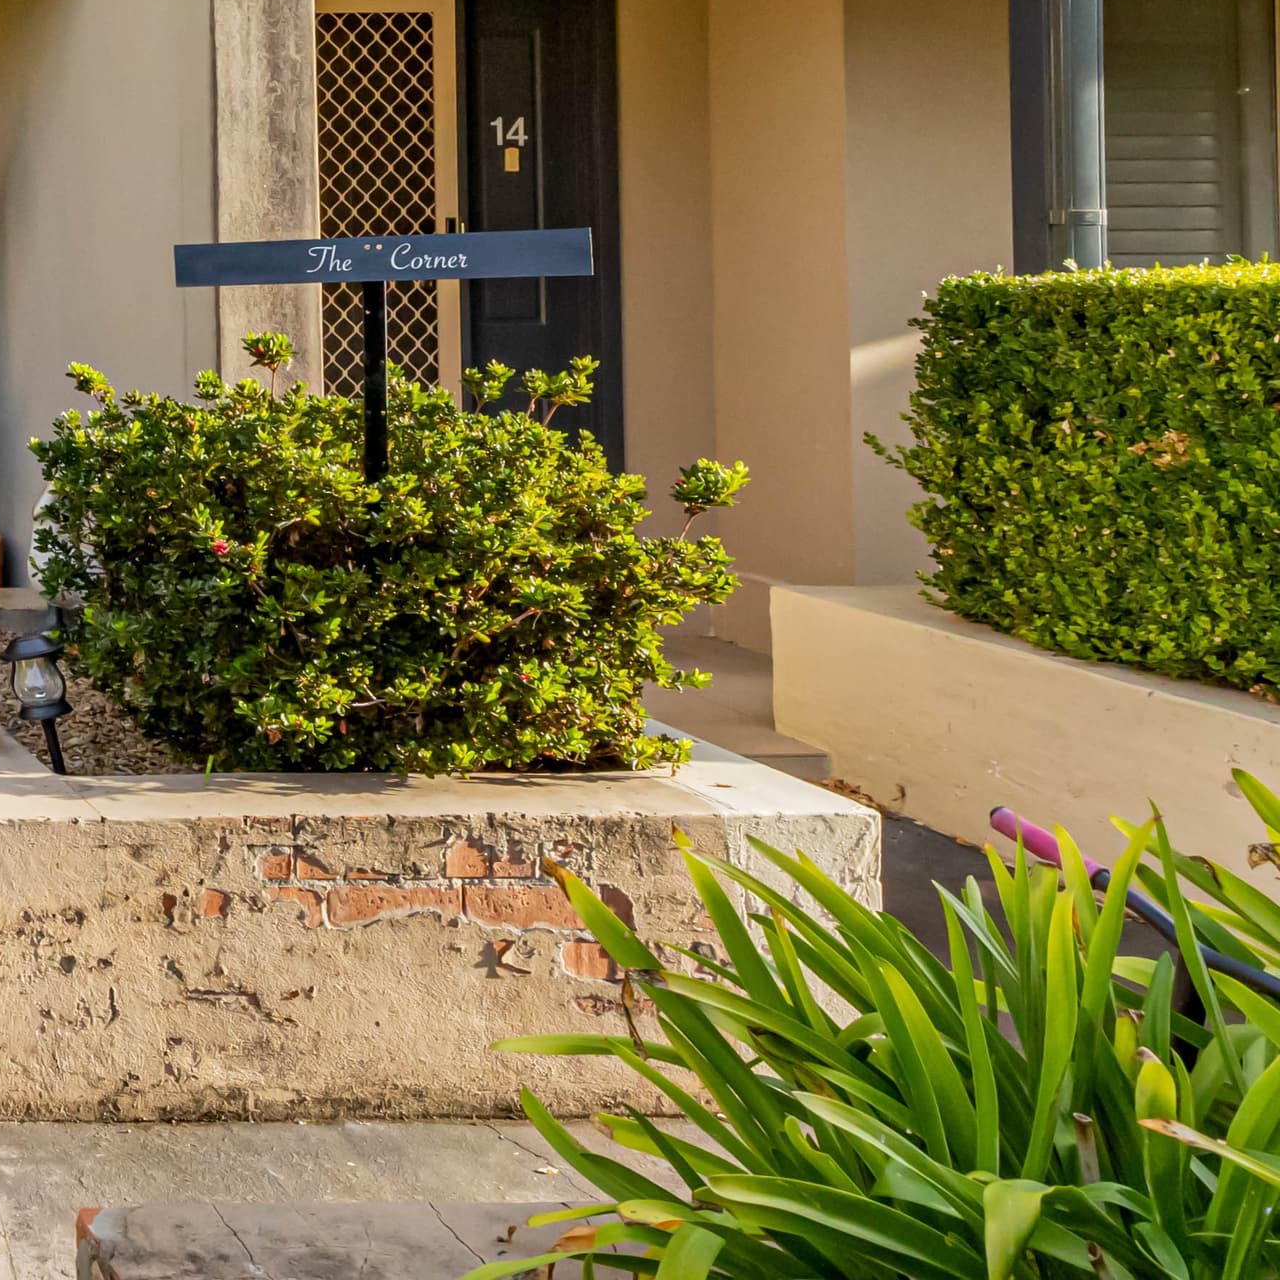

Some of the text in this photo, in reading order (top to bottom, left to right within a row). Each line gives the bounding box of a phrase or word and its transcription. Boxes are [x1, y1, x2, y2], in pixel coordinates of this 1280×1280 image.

[490, 116, 528, 147] 14
[306, 243, 468, 273] The Corner
